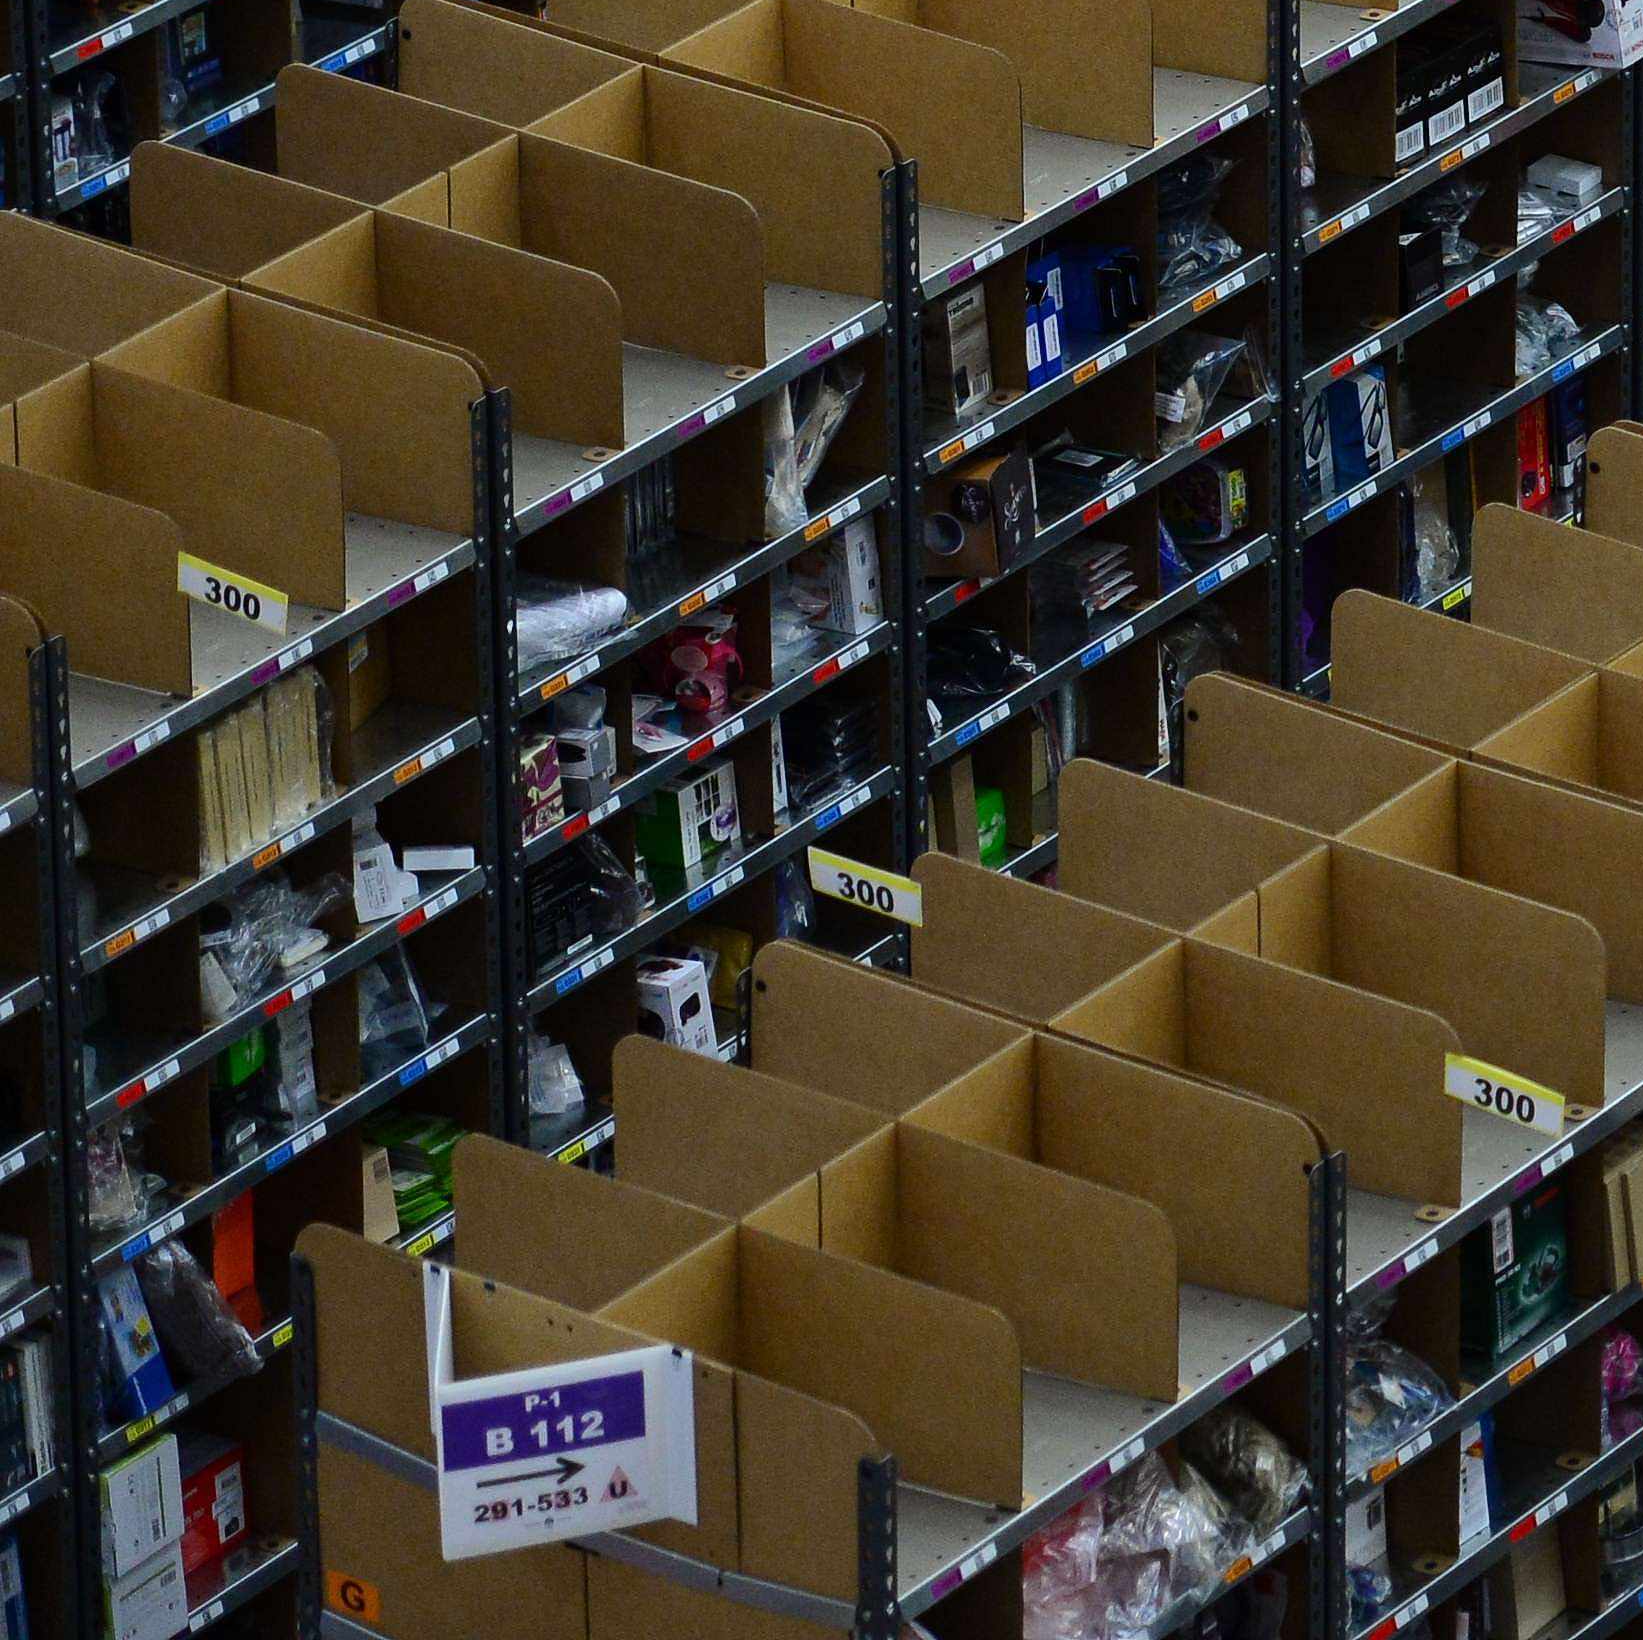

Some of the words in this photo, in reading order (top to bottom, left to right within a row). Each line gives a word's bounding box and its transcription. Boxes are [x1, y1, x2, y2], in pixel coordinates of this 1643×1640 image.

[205, 577, 260, 620] 300
[838, 873, 893, 912] 300
[1475, 1079, 1534, 1123] 300
[524, 1391, 561, 1412] P-1
[486, 1427, 514, 1456] B
[530, 1409, 605, 1448] 112
[474, 1487, 588, 1523] 291-533
[609, 1480, 628, 1499] U
[341, 1580, 365, 1612] G
